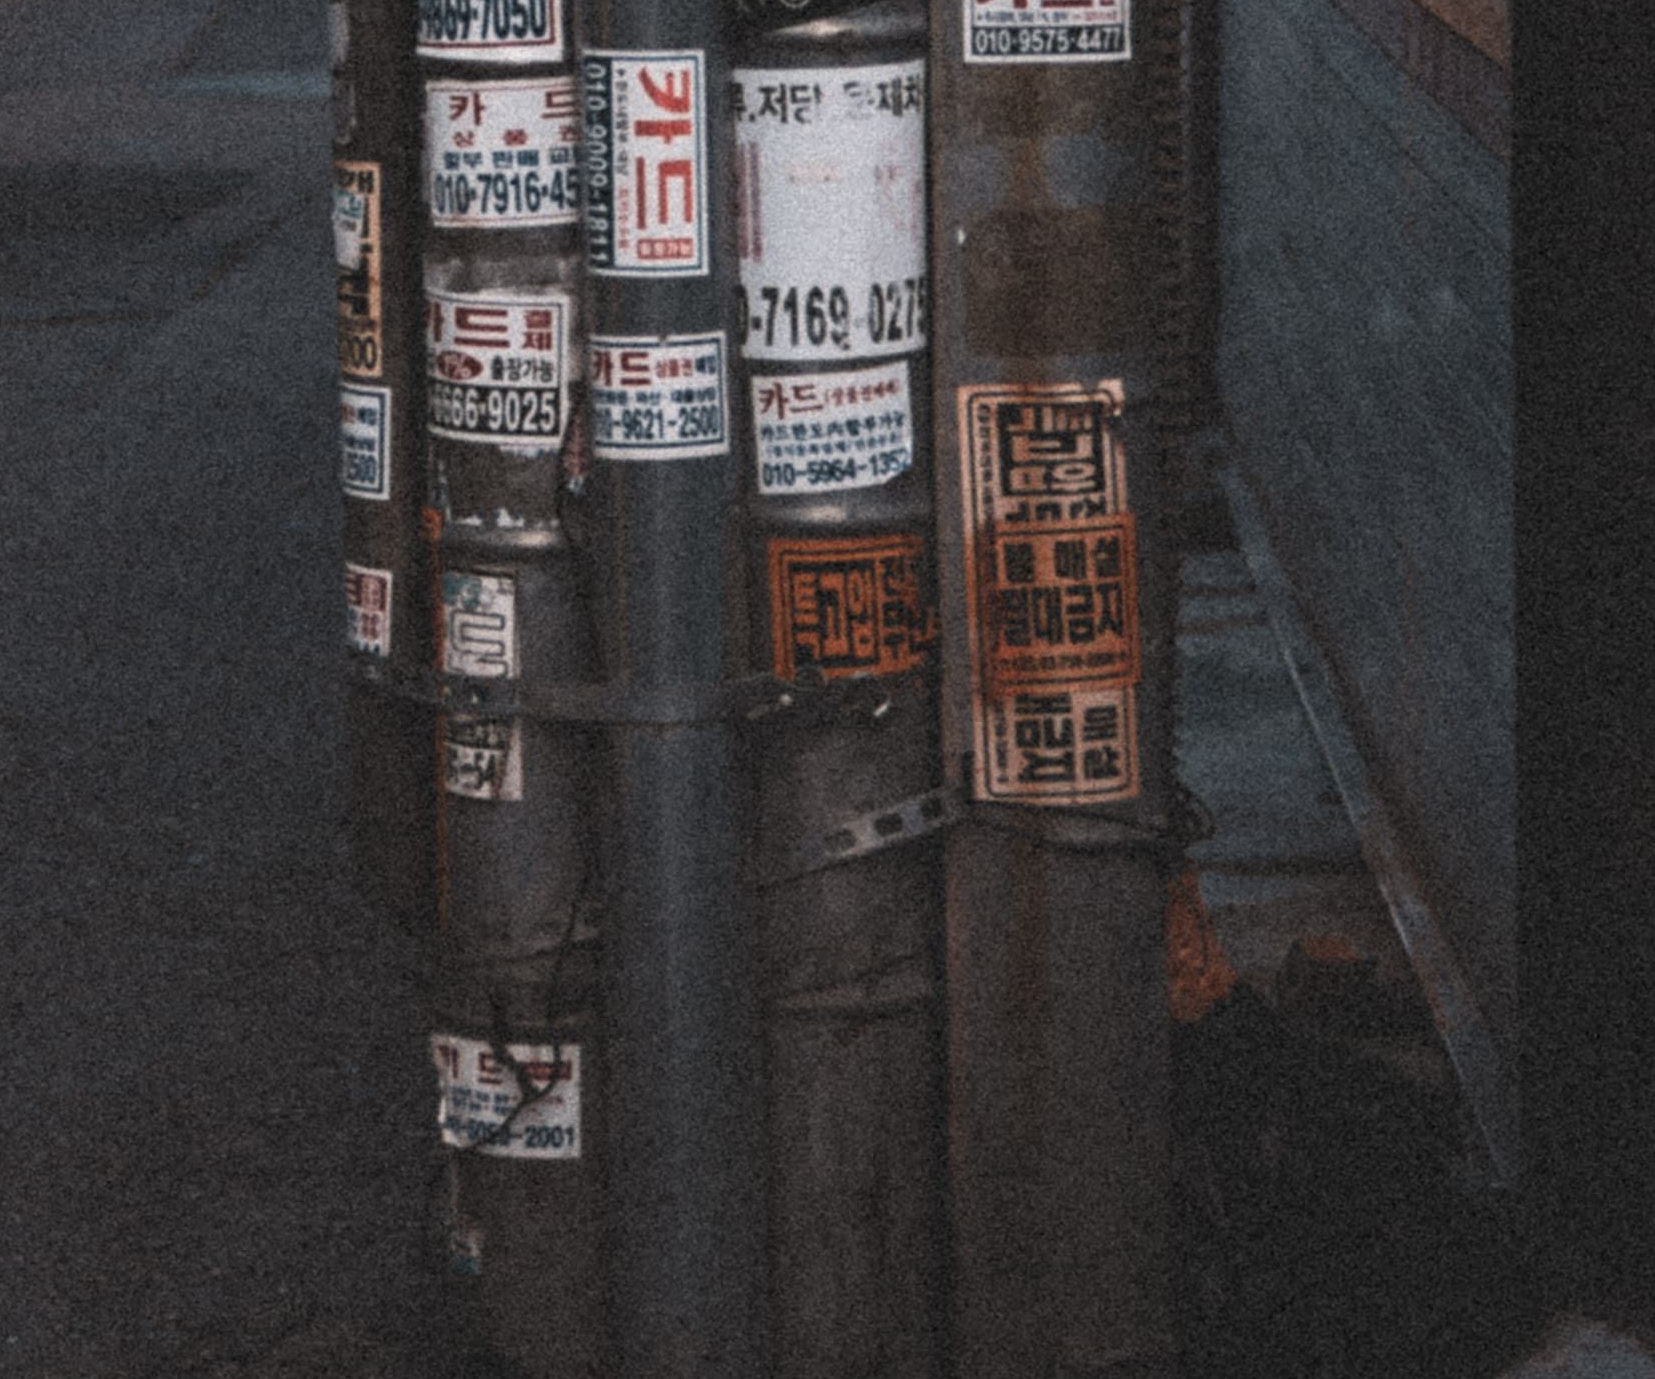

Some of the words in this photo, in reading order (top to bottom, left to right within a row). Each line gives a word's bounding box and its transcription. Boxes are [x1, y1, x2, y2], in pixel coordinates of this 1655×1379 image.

[633, 66, 694, 231] 카드
[593, 351, 652, 387] 카드
[759, 382, 823, 420] 카드
